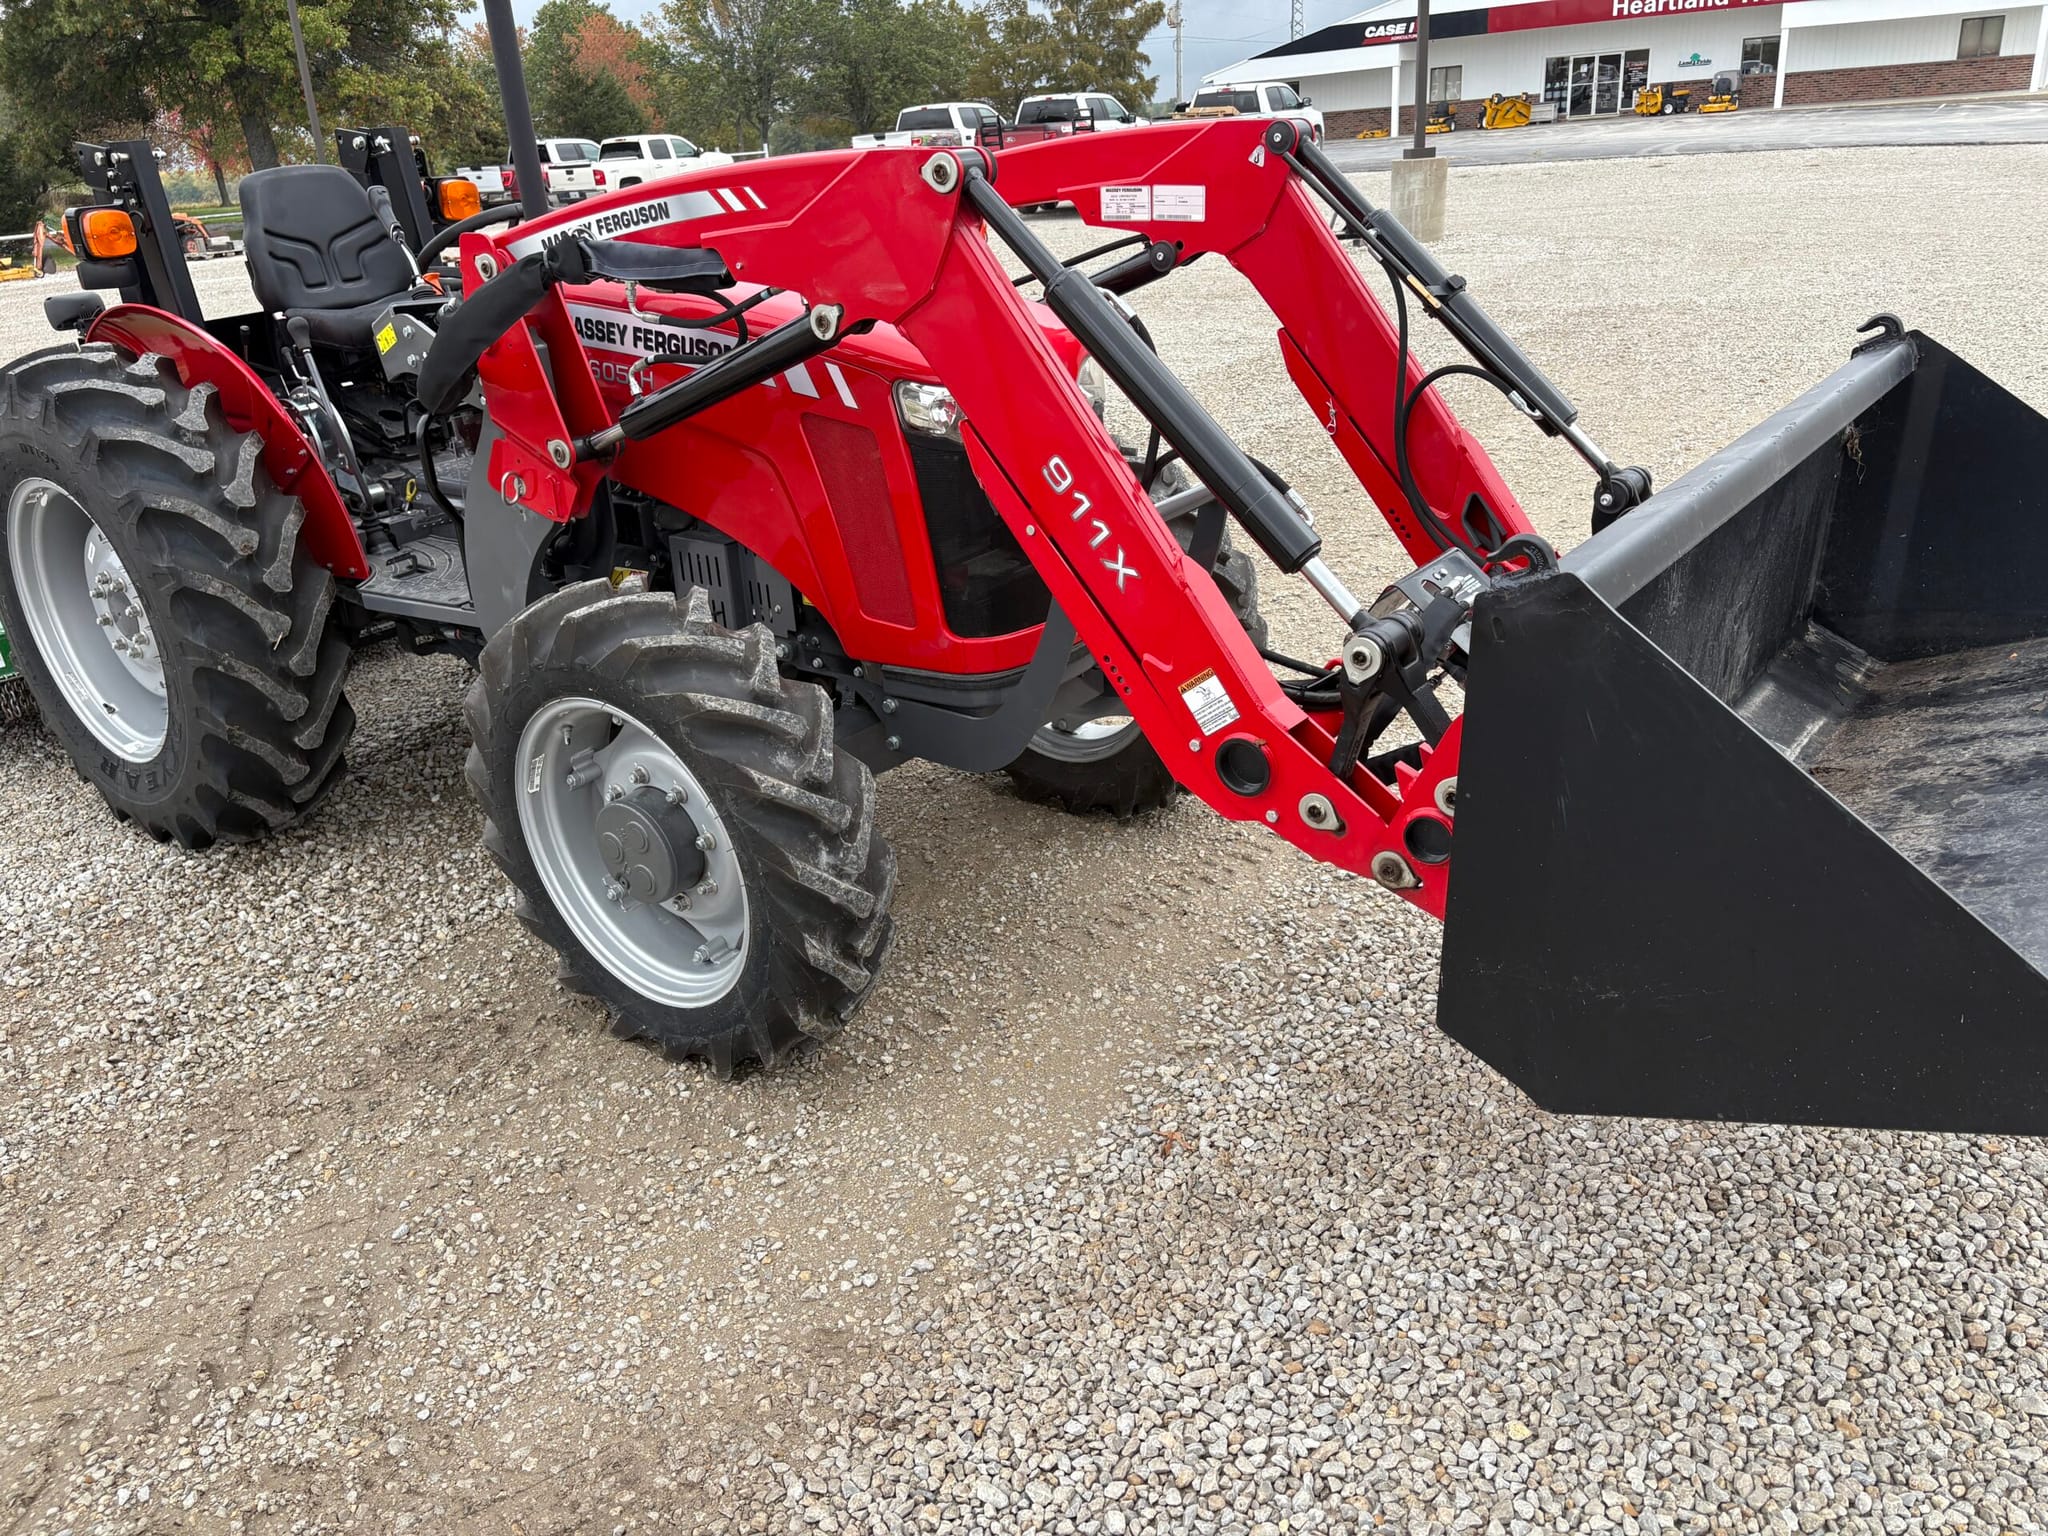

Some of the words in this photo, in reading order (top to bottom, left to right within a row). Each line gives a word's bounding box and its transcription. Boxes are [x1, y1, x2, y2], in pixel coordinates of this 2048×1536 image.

[1365, 22, 1407, 37] CASE
[595, 201, 671, 236] FERGUSON
[574, 316, 628, 346] ASSEY
[1042, 455, 1141, 593] 911X
[1186, 668, 1214, 695] WARNING
